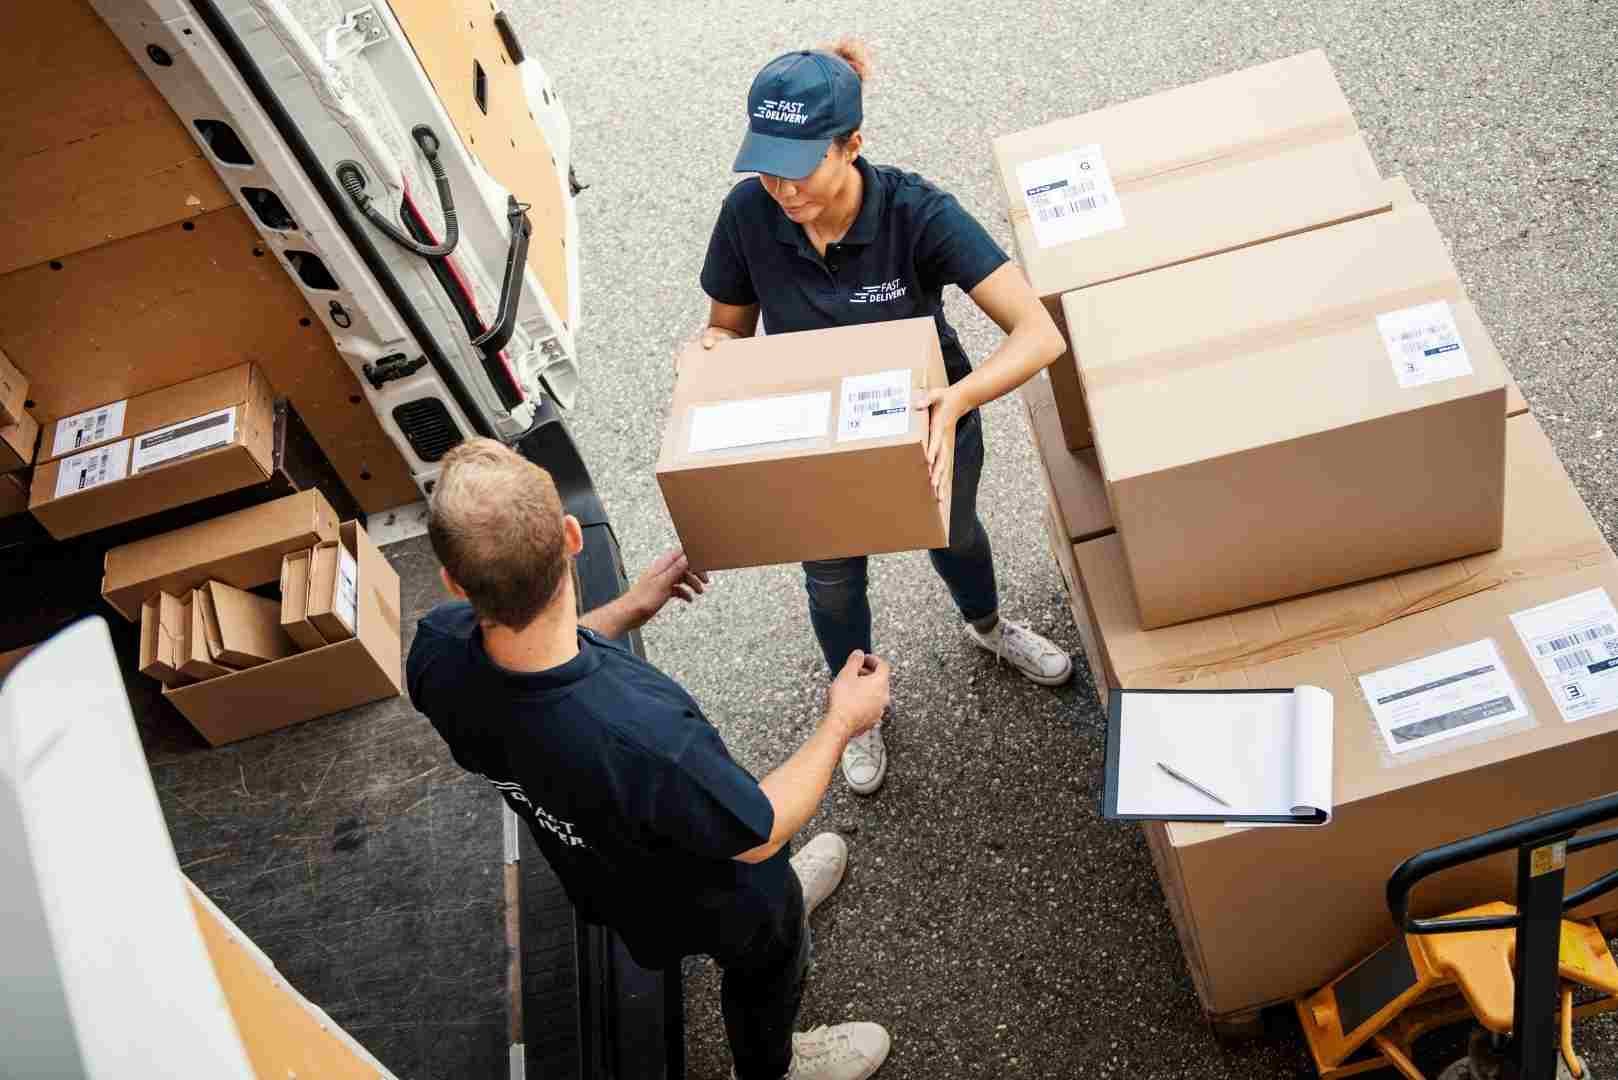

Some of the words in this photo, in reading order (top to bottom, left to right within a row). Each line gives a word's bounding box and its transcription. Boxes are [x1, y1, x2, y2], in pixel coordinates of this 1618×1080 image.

[778, 100, 804, 113] FAST
[765, 110, 808, 125] DELIVERY
[881, 278, 900, 292] FAST
[869, 287, 907, 303] DELIVERY
